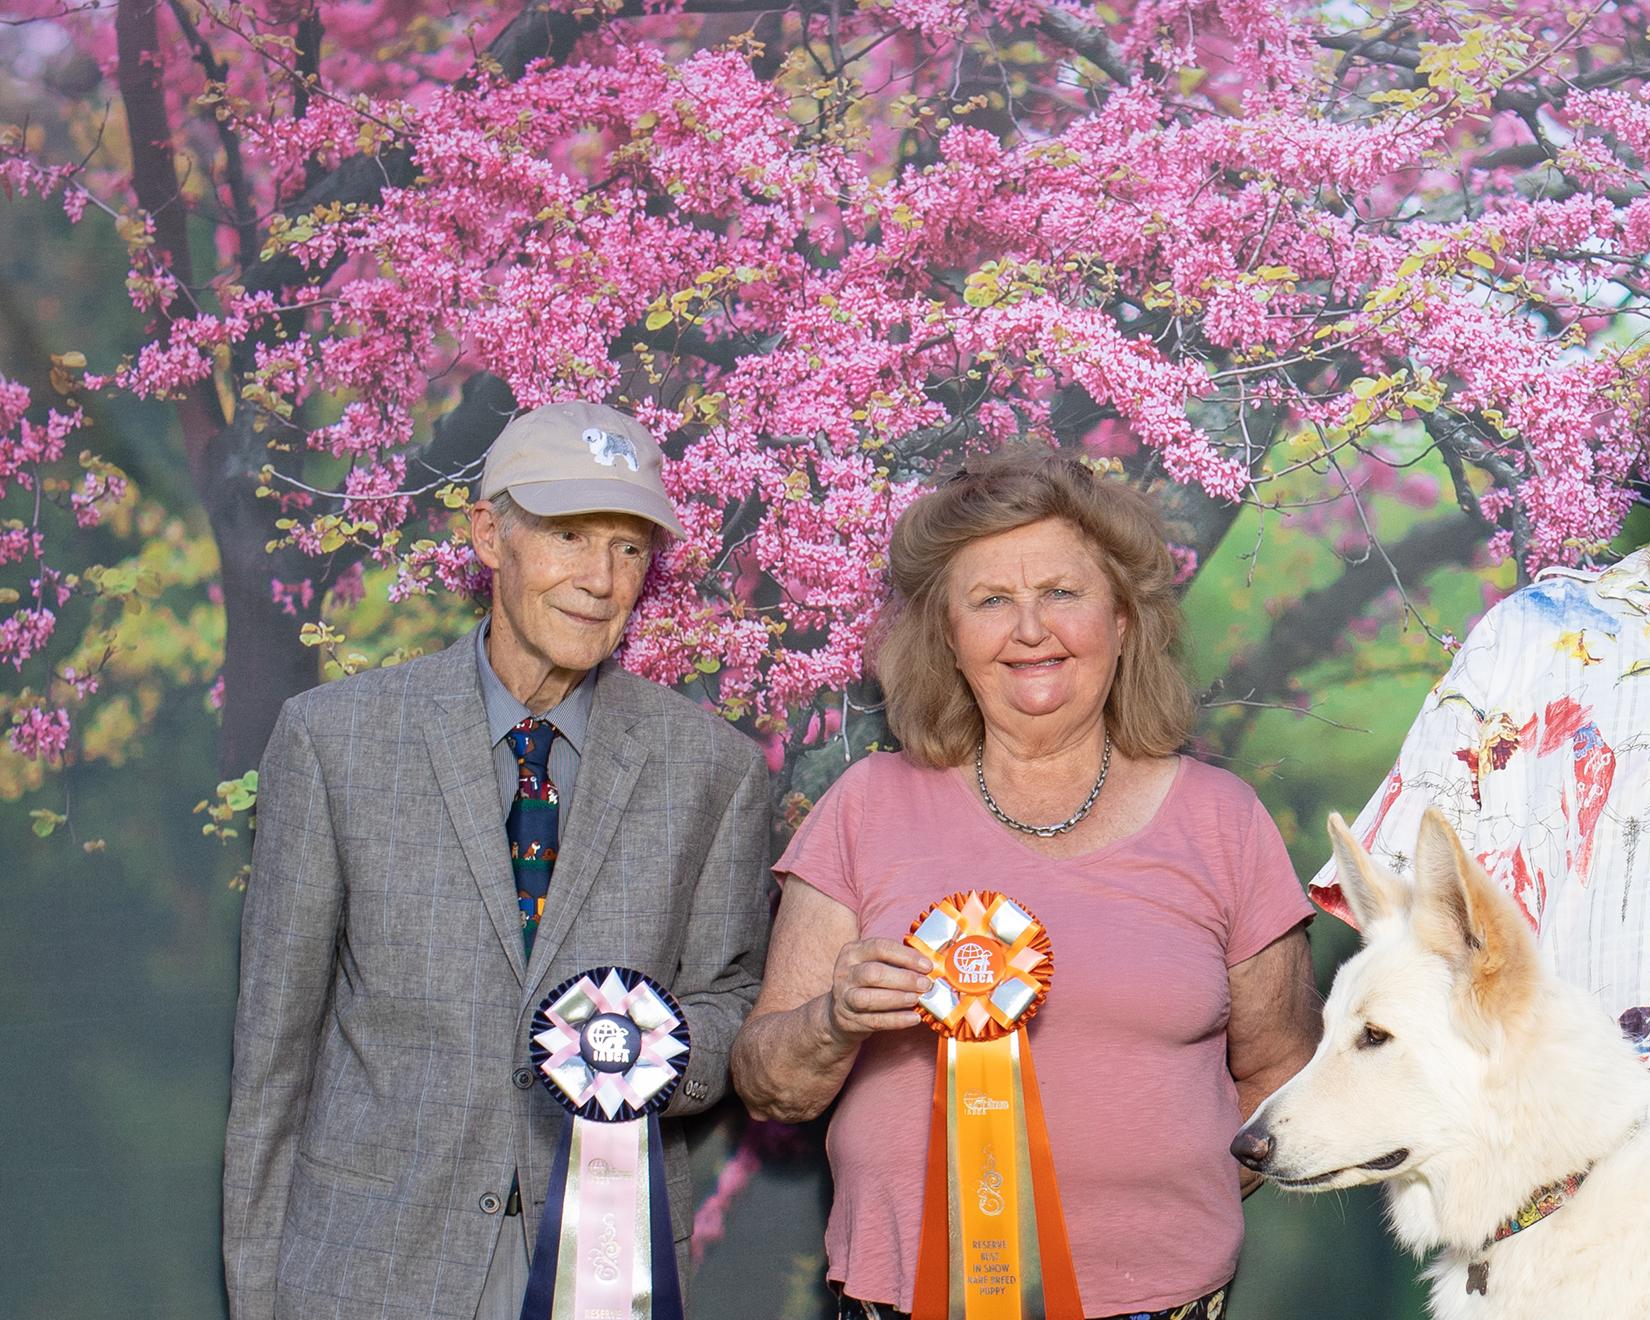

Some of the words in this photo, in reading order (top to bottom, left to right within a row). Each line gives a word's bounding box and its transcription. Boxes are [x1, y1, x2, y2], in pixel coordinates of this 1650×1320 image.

[959, 973, 994, 985] IABCA
[971, 1240, 1007, 1249] RESERVE
[972, 1264, 982, 1272] IN
[984, 1264, 1010, 1273] SHOW
[979, 1287, 1006, 1295] PUPPY
